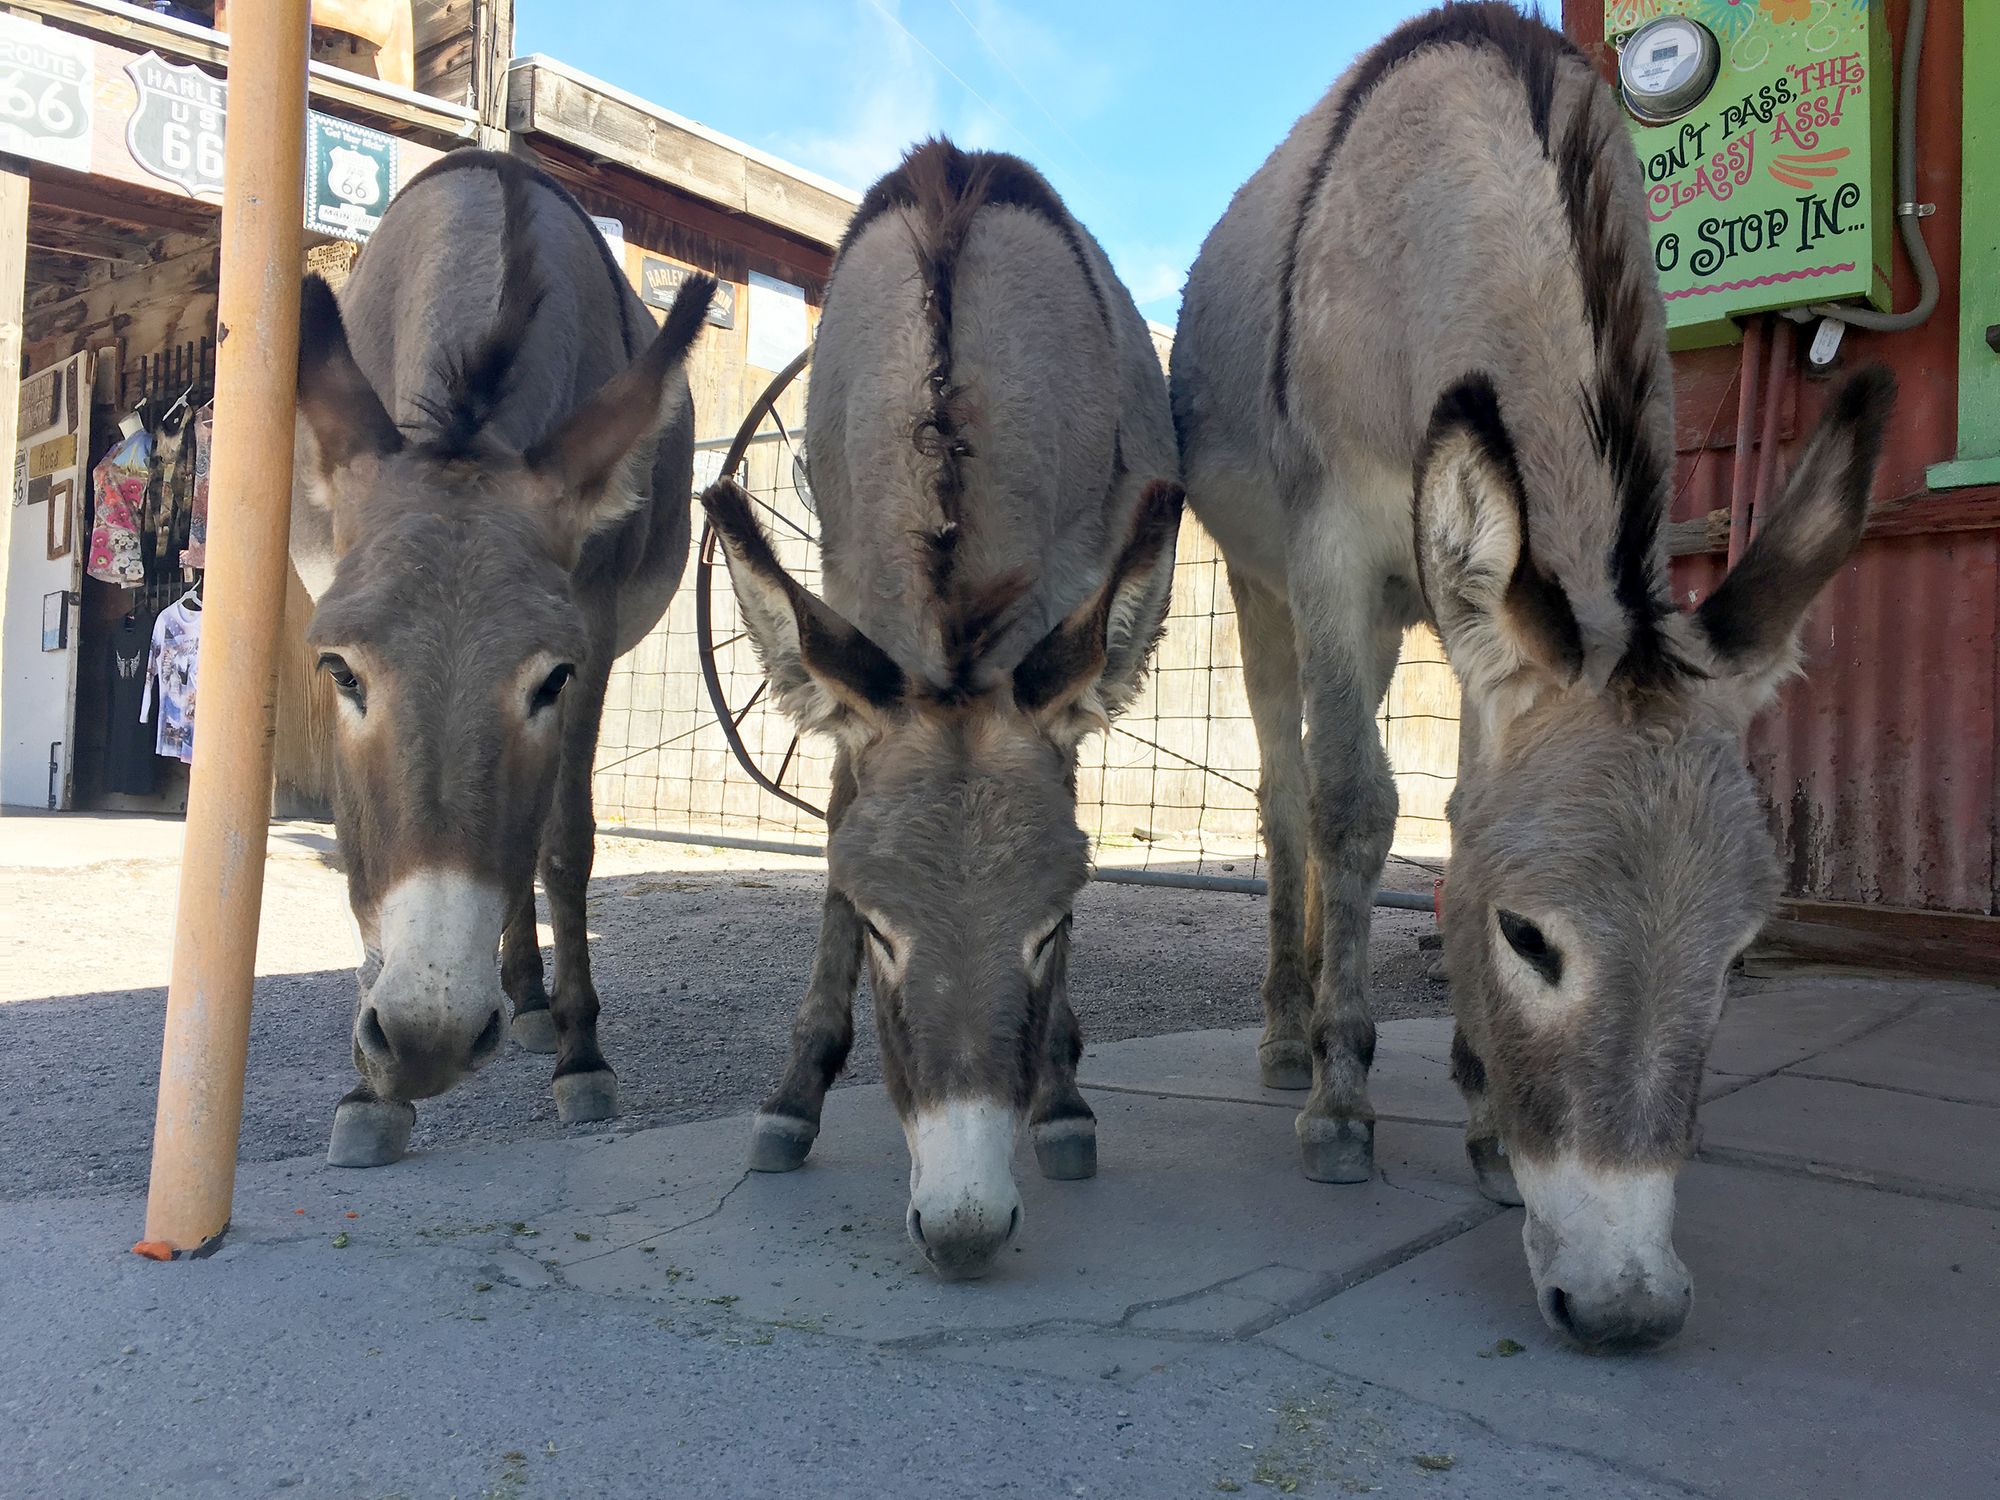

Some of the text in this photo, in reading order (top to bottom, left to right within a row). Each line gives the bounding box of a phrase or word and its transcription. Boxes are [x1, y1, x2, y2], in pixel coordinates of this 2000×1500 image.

[3, 69, 74, 131] 66
[147, 67, 228, 107] HARLE
[1639, 51, 1865, 182] ONT PASS, "THE
[162, 121, 224, 179] 66
[1648, 84, 1862, 222] CLASSY ASS!"
[341, 177, 366, 199] 66
[1655, 182, 1865, 277] O STOP IN...
[646, 268, 684, 290] HARLEY
